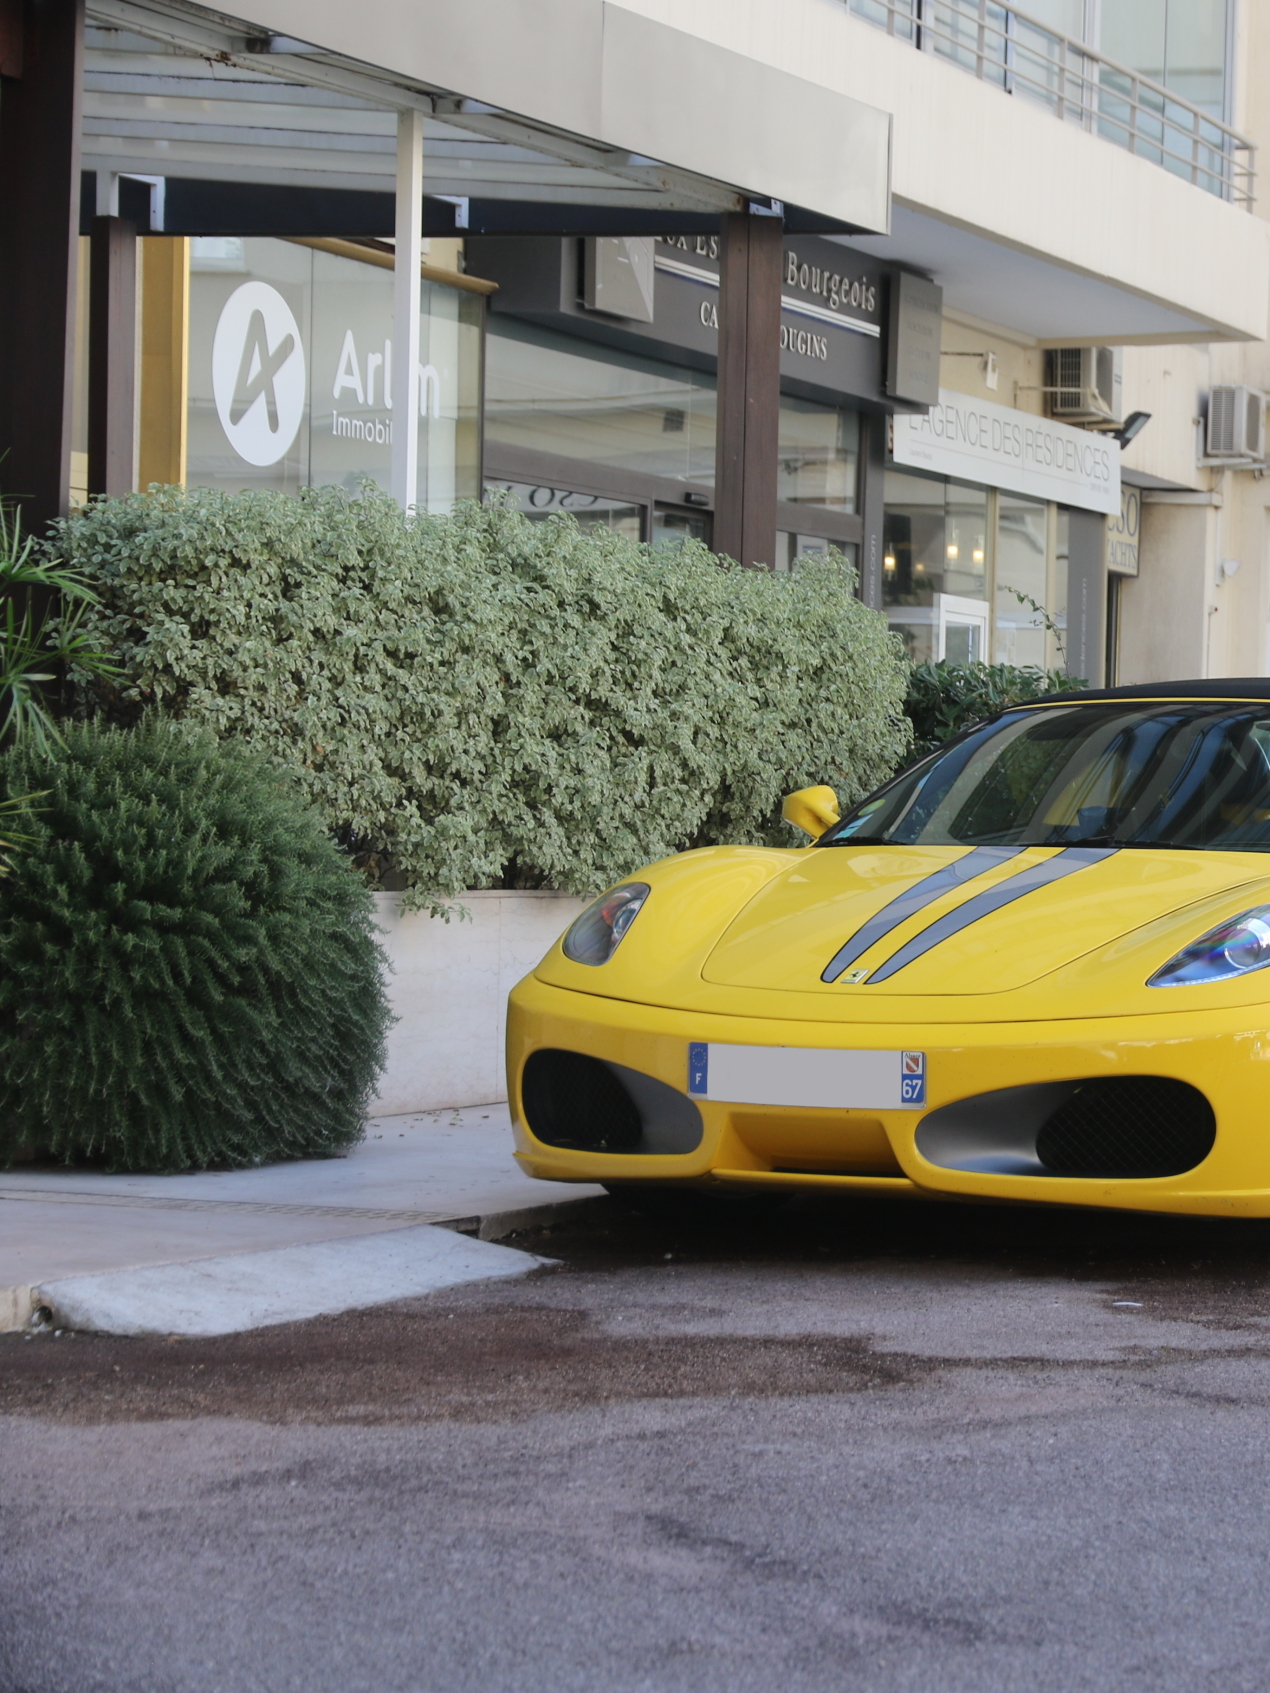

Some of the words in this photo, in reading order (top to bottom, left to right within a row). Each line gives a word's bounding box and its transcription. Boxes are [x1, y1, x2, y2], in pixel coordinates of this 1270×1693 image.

[786, 251, 876, 312] Bourgeois
[701, 301, 719, 330] CA
[780, 324, 828, 361] OUGINS
[333, 329, 440, 419] Arlm
[332, 410, 392, 445] Immobil
[909, 402, 988, 449] LAGENCE
[992, 419, 1021, 459] DES
[1025, 424, 1110, 482] RÉSIDENCES
[1108, 538, 1138, 570] ACHTS
[695, 1072, 703, 1085] F
[902, 1079, 922, 1099] 67
